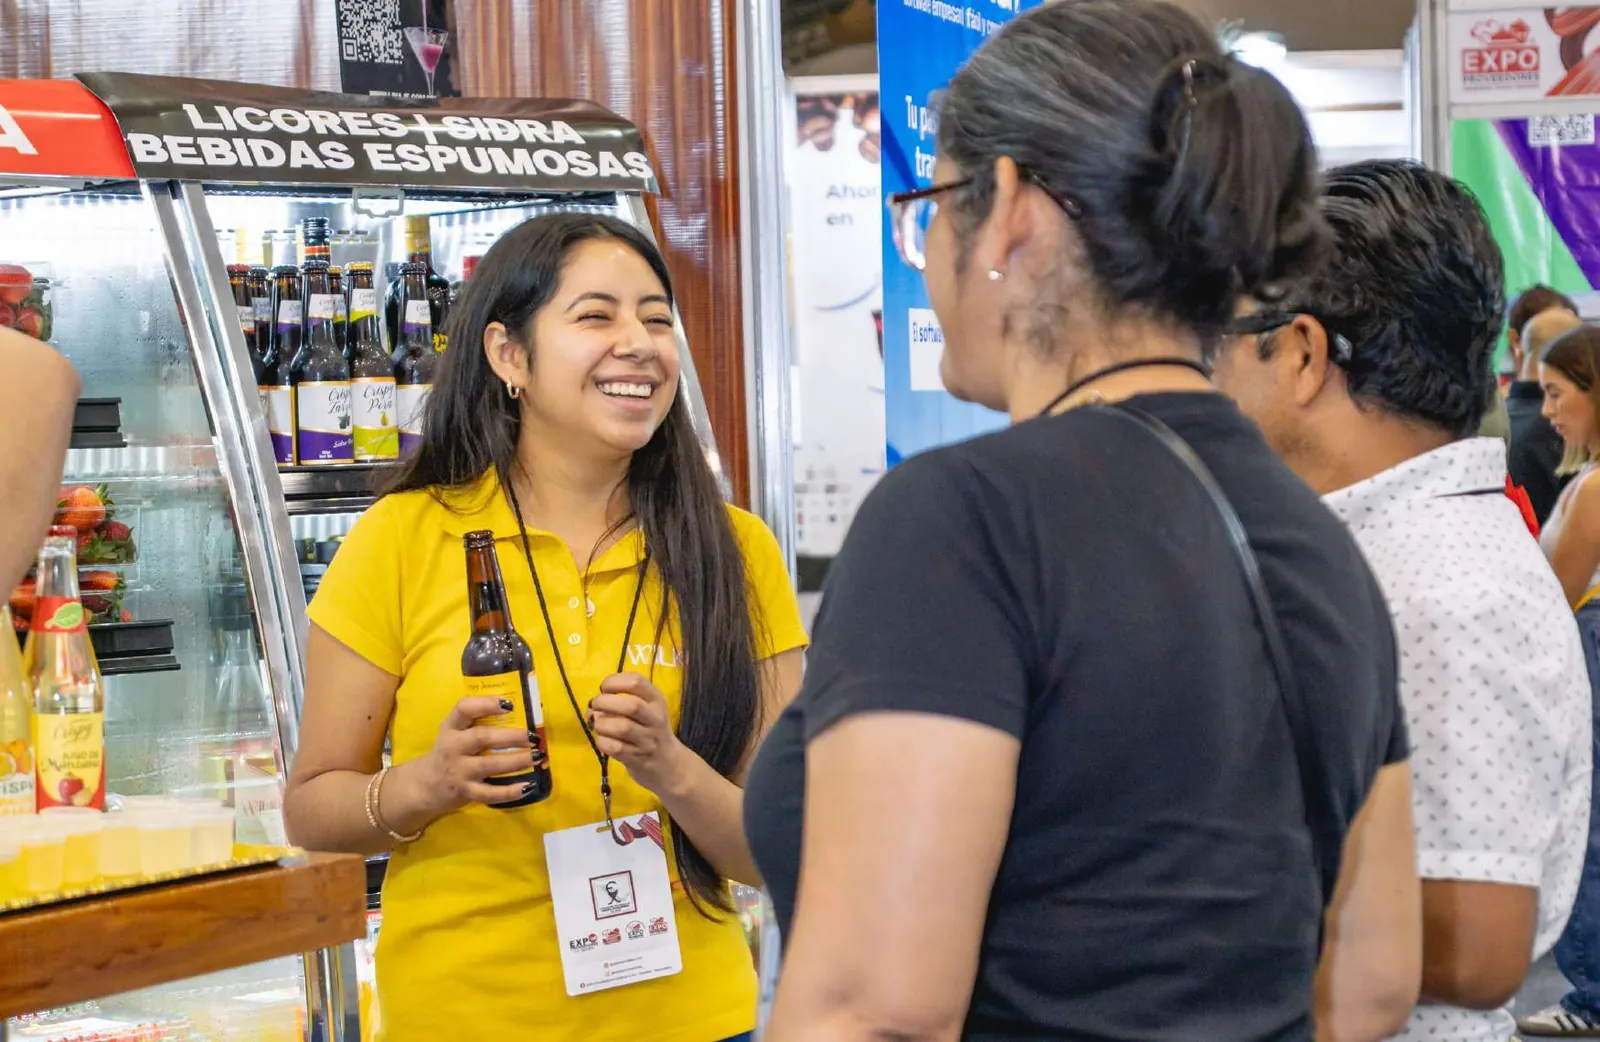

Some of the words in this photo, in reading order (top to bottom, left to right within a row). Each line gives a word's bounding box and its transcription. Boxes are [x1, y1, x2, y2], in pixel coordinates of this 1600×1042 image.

[1464, 50, 1538, 71] EXPO
[183, 103, 407, 138] LICORES
[442, 116, 585, 144] SIDRA
[905, 95, 917, 129] Tu
[127, 132, 355, 169] BEBIDAS
[363, 143, 653, 178] ESPUMOSAS
[827, 213, 853, 225] en
